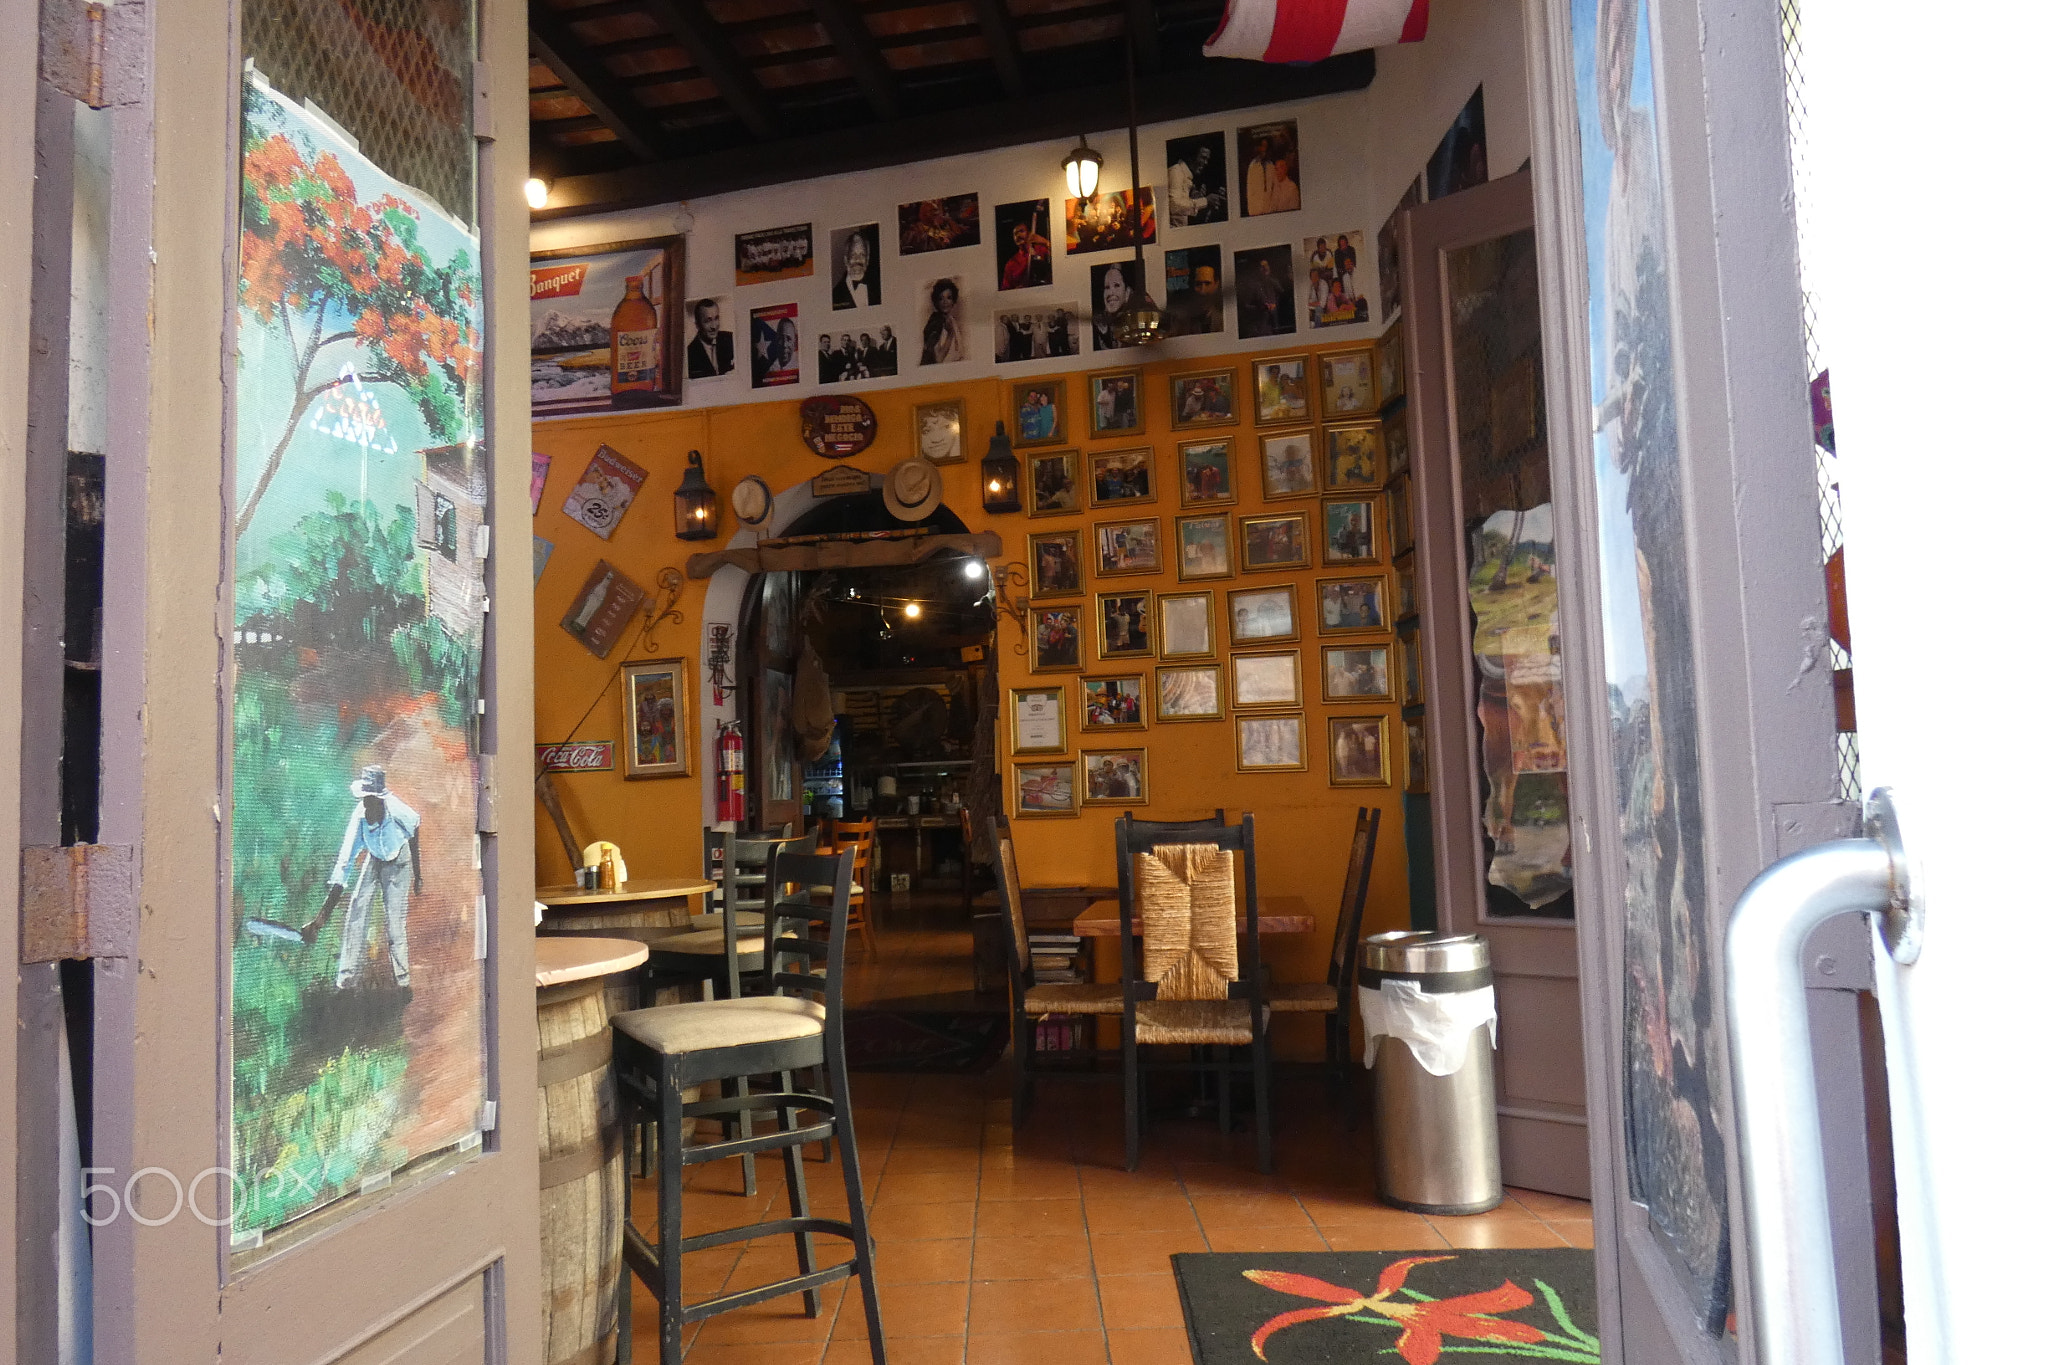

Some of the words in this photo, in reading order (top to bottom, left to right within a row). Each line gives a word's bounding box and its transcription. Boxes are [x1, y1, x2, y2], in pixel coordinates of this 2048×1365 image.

[530, 268, 581, 297] Banquet
[619, 333, 648, 347] Coors
[620, 361, 647, 370] BEER
[598, 449, 643, 483] Budweiser
[541, 745, 606, 768] Coca-Cola
